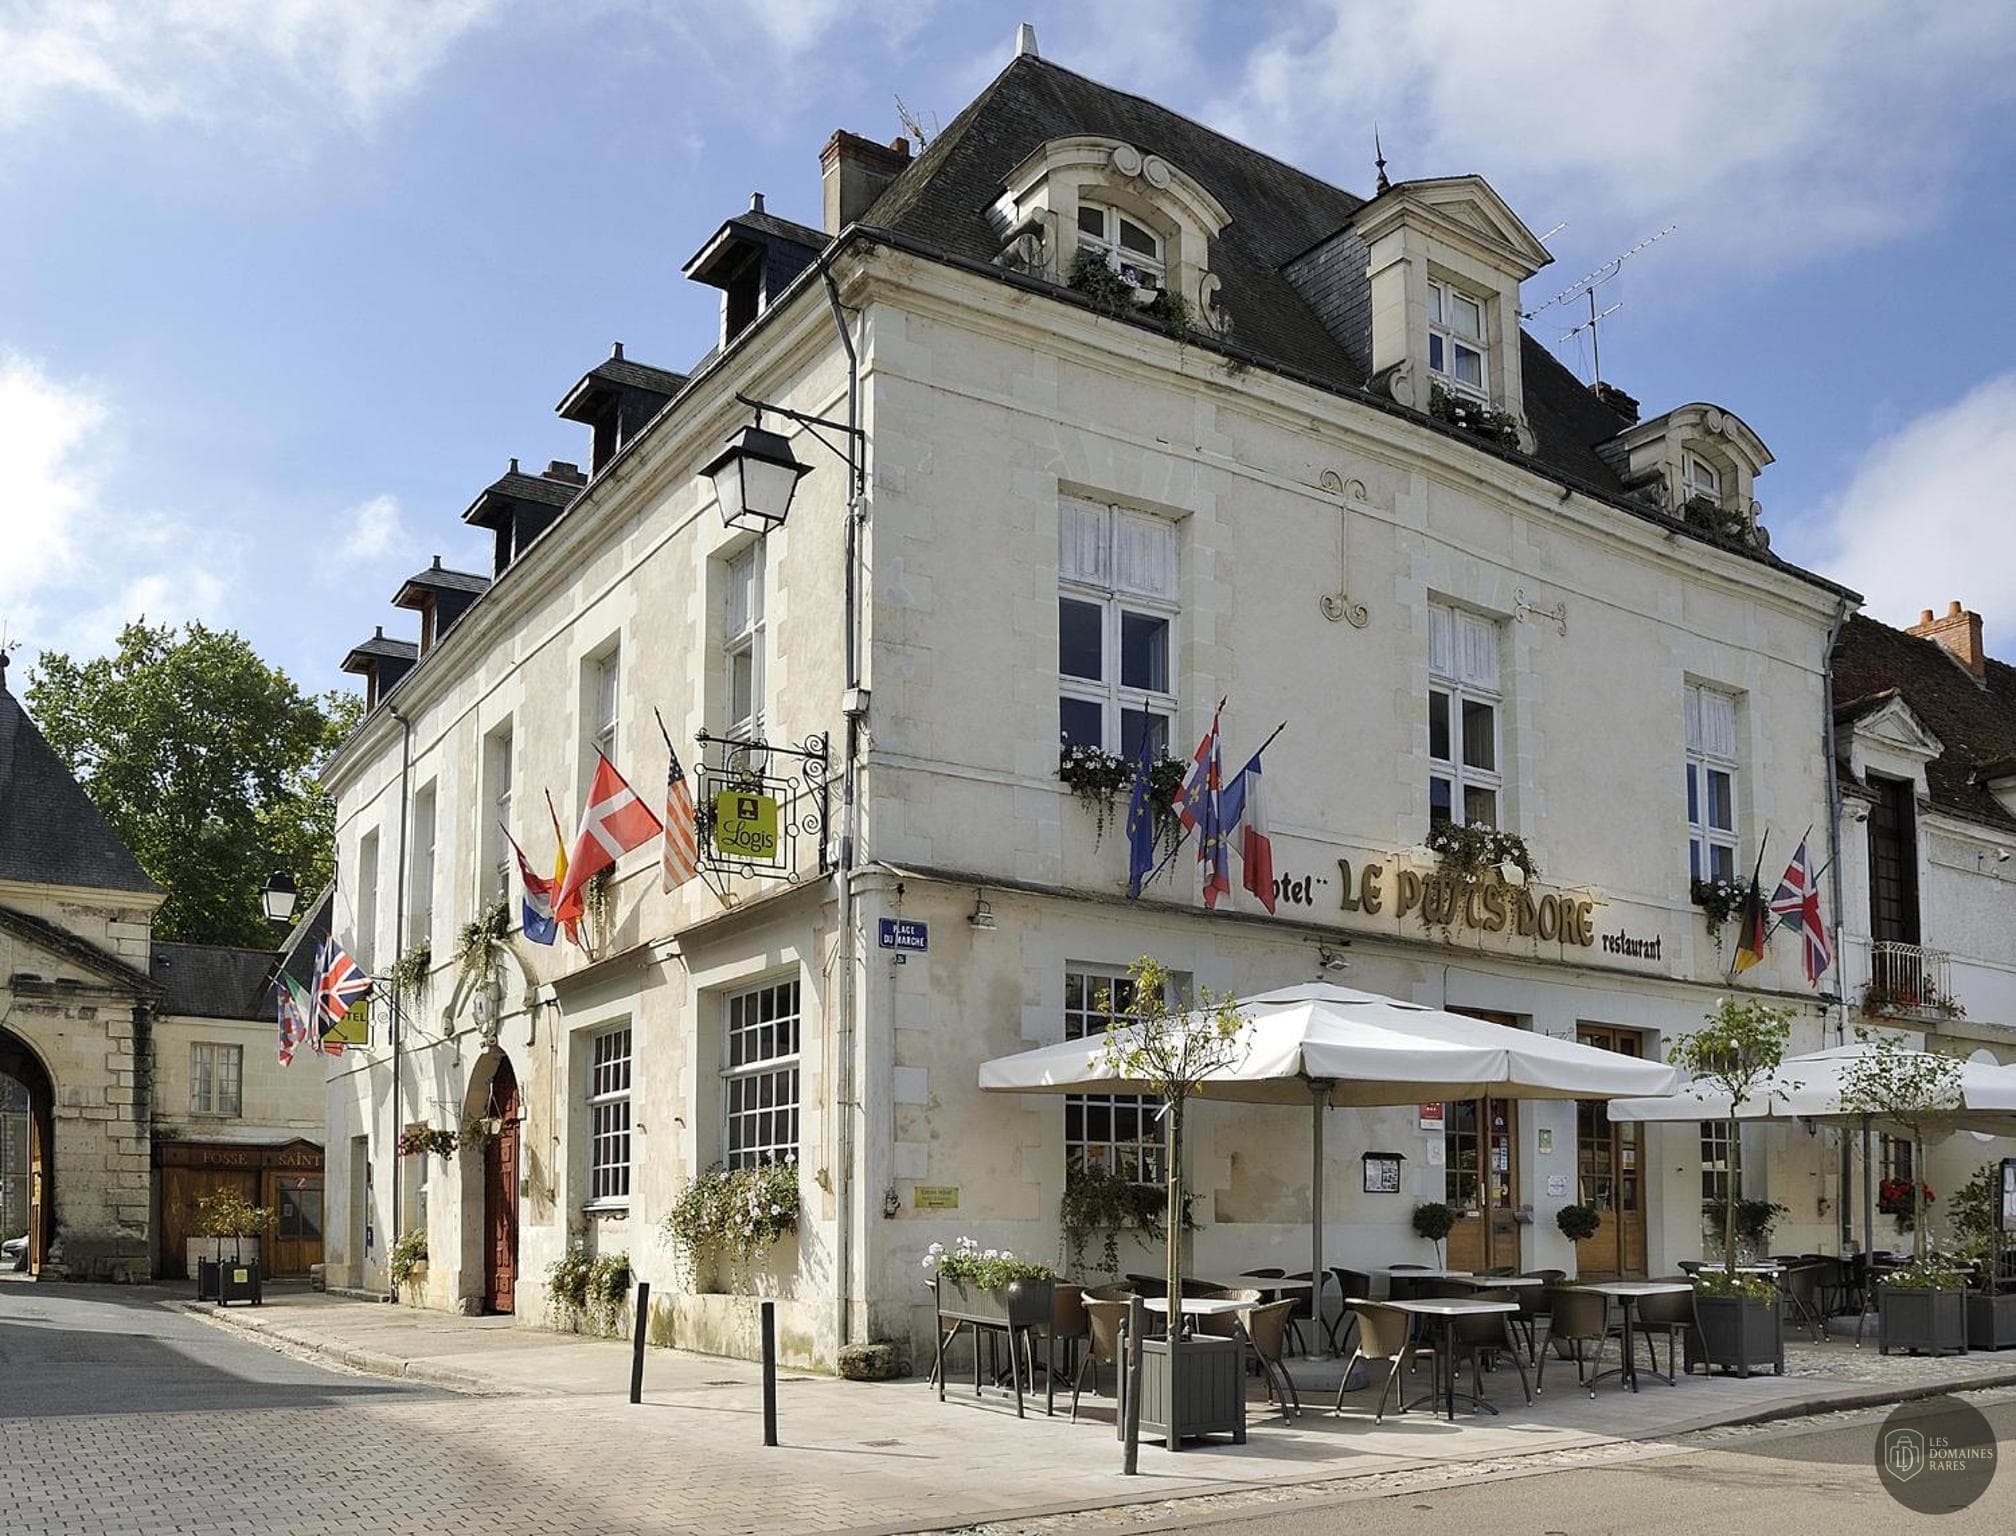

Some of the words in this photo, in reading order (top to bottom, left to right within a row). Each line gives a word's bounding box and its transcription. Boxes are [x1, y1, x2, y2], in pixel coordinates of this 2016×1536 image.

[721, 820, 774, 852] Logis
[1338, 859, 1383, 914] LE
[1601, 928, 1662, 961] restaurant
[883, 934, 894, 944] DU
[893, 924, 915, 935] PLACE
